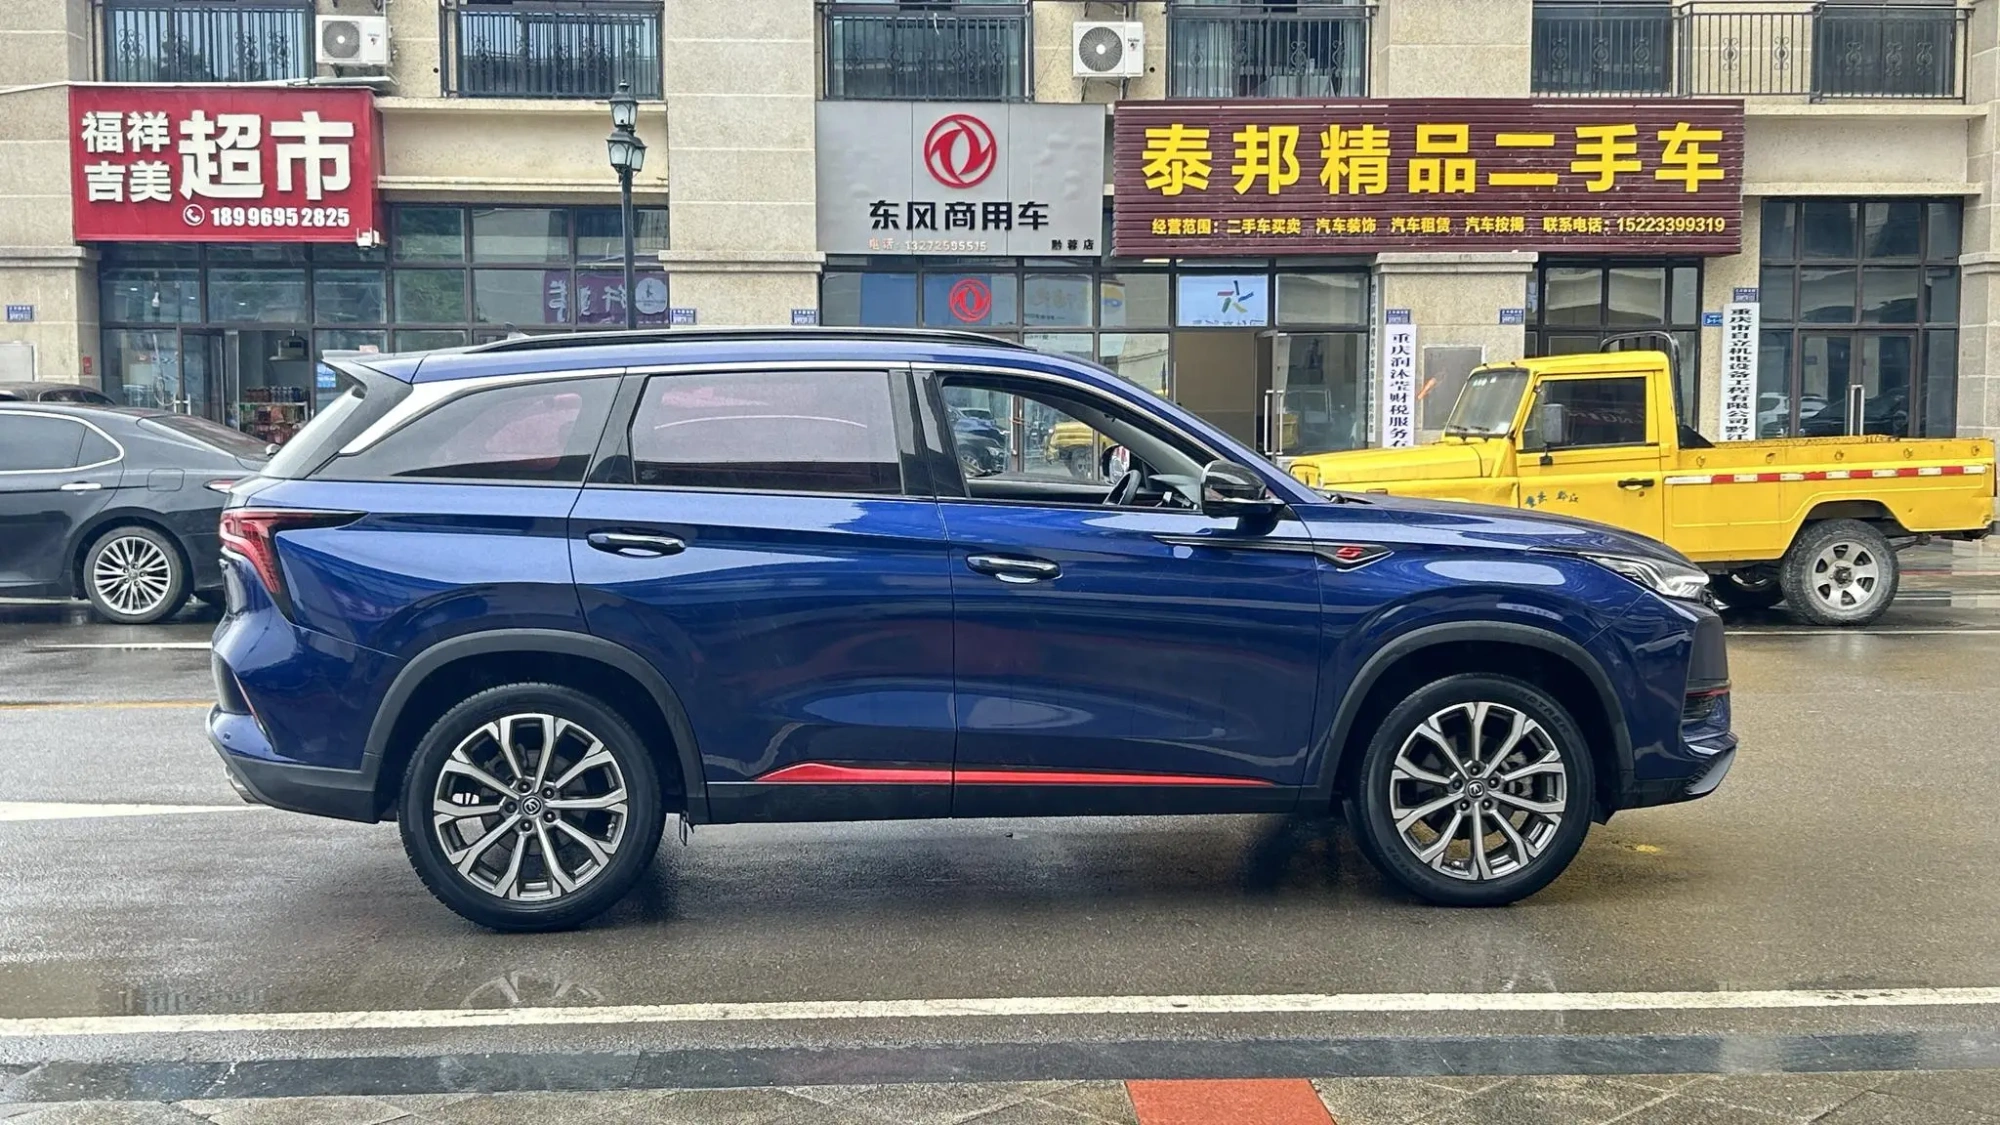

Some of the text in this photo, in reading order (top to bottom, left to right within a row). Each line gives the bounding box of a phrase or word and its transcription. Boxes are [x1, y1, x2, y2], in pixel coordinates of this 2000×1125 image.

[81, 111, 171, 153] 福祥
[178, 109, 354, 201] 超市
[1142, 122, 1725, 196] 泰邦精品二手车
[84, 160, 173, 202] 吉美
[869, 200, 1049, 231] 东风商用车
[1316, 217, 1377, 234] 汽车装饰
[1391, 217, 1450, 234] 汽车租赁
[1465, 216, 1525, 233] 汽车按揭
